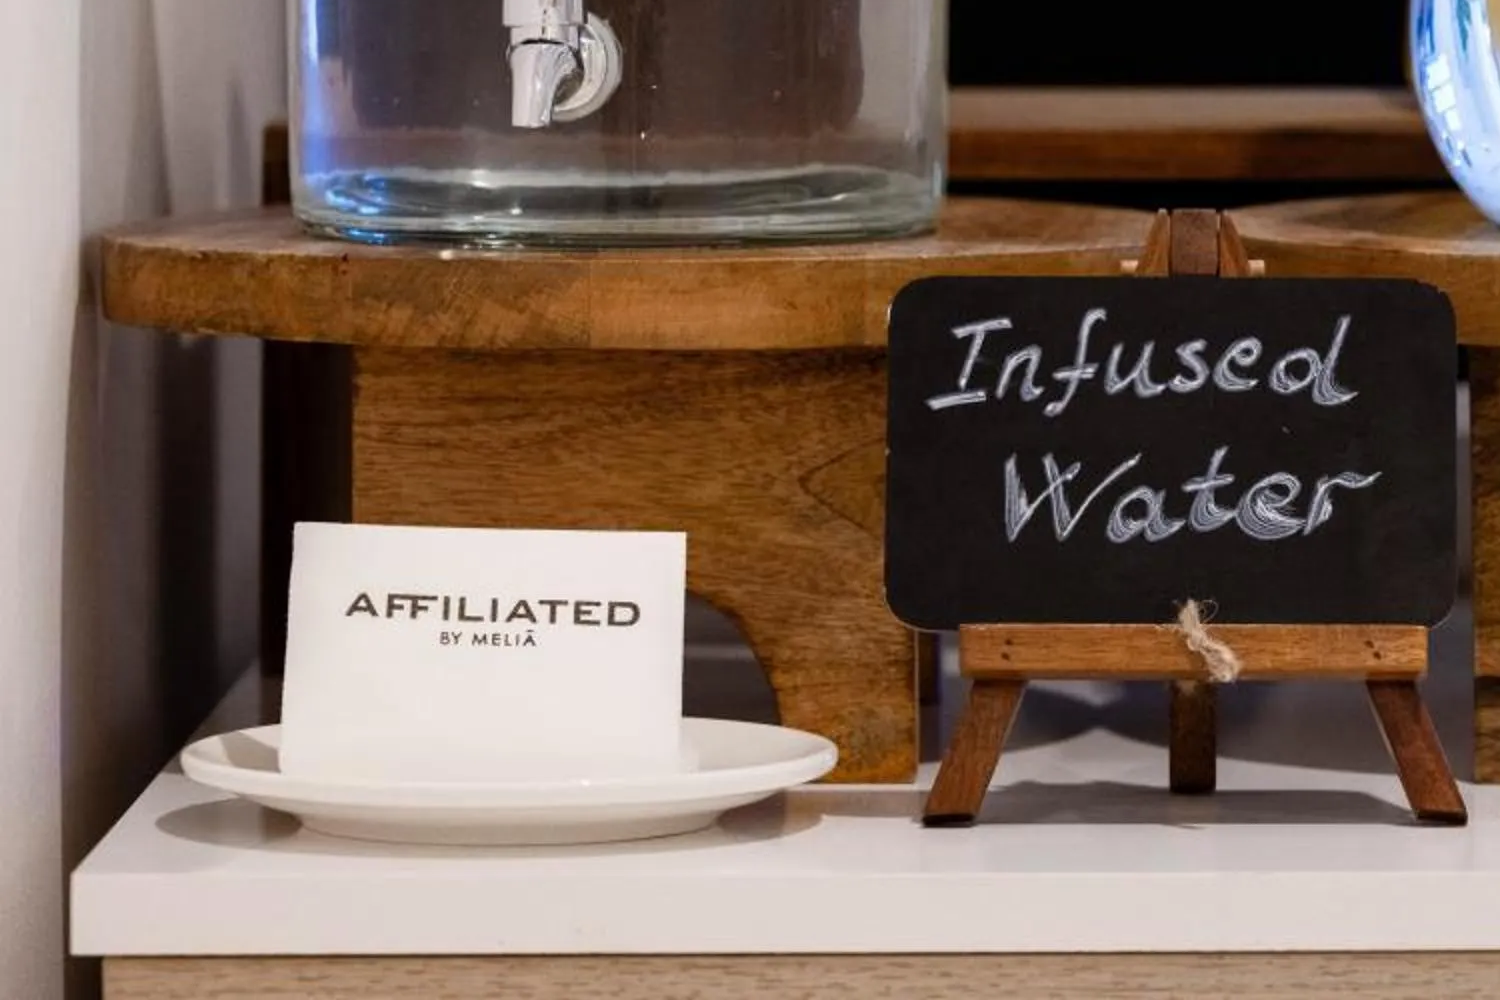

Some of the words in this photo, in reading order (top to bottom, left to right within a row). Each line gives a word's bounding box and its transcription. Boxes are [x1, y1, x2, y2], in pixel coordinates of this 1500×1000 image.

[926, 307, 1359, 417] Infused
[1003, 445, 1383, 543] Water
[345, 592, 642, 627] AFFILIATED
[439, 631, 462, 645] BY
